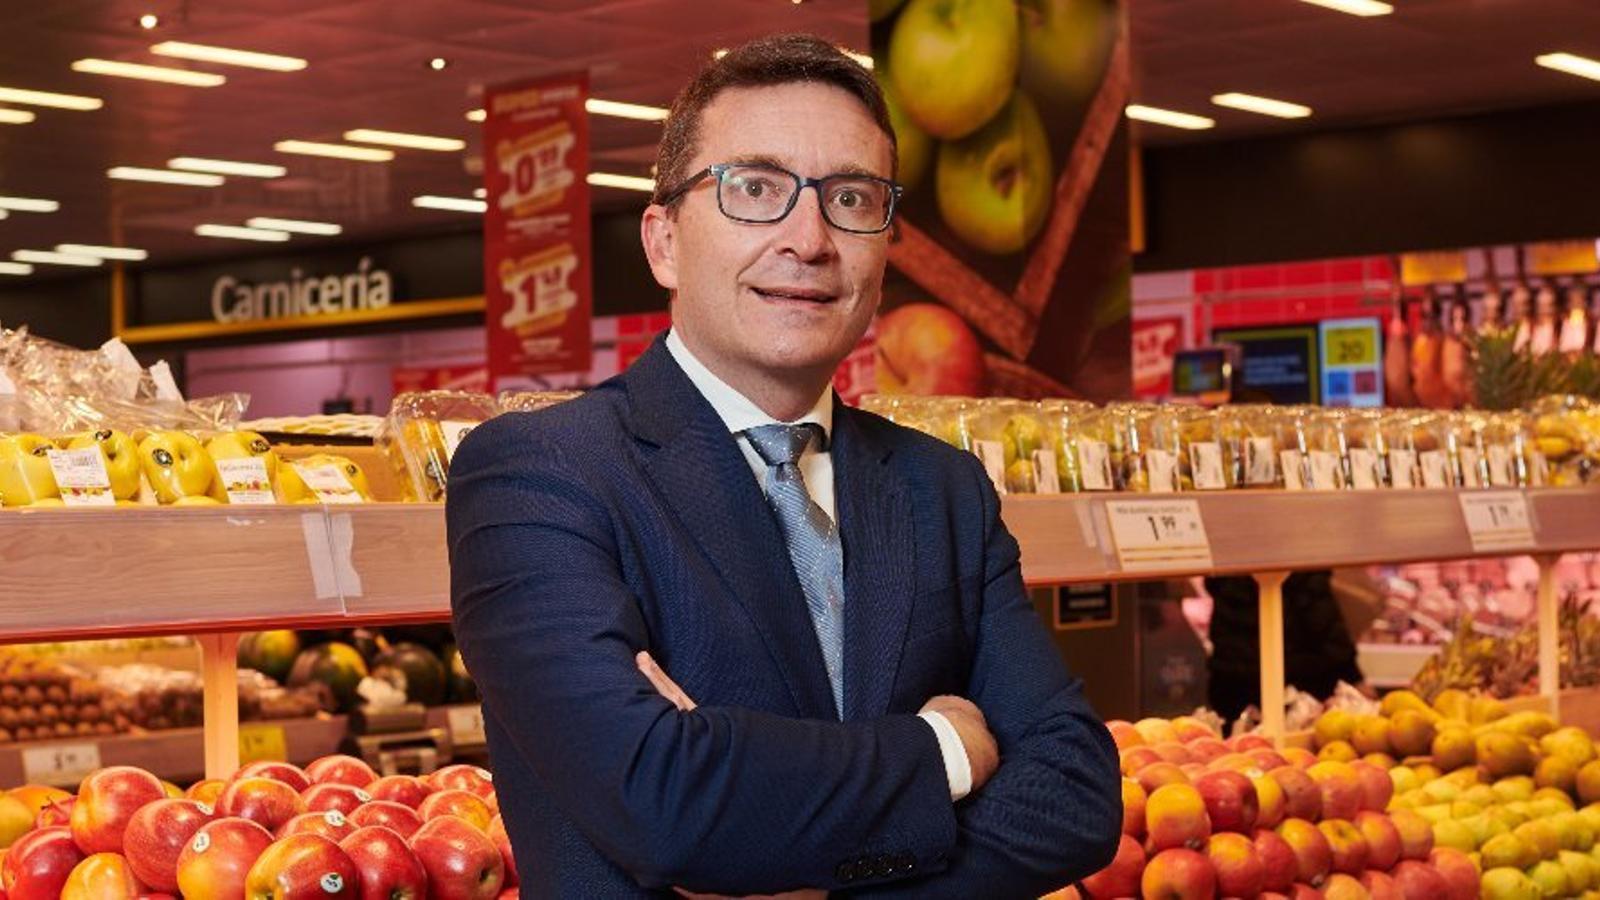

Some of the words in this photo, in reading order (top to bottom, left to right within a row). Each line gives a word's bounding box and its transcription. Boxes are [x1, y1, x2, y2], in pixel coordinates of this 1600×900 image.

[516, 155, 535, 195] 0
[211, 257, 391, 323] Carnicería
[520, 275, 536, 314] 1
[1143, 516, 1160, 541] 1
